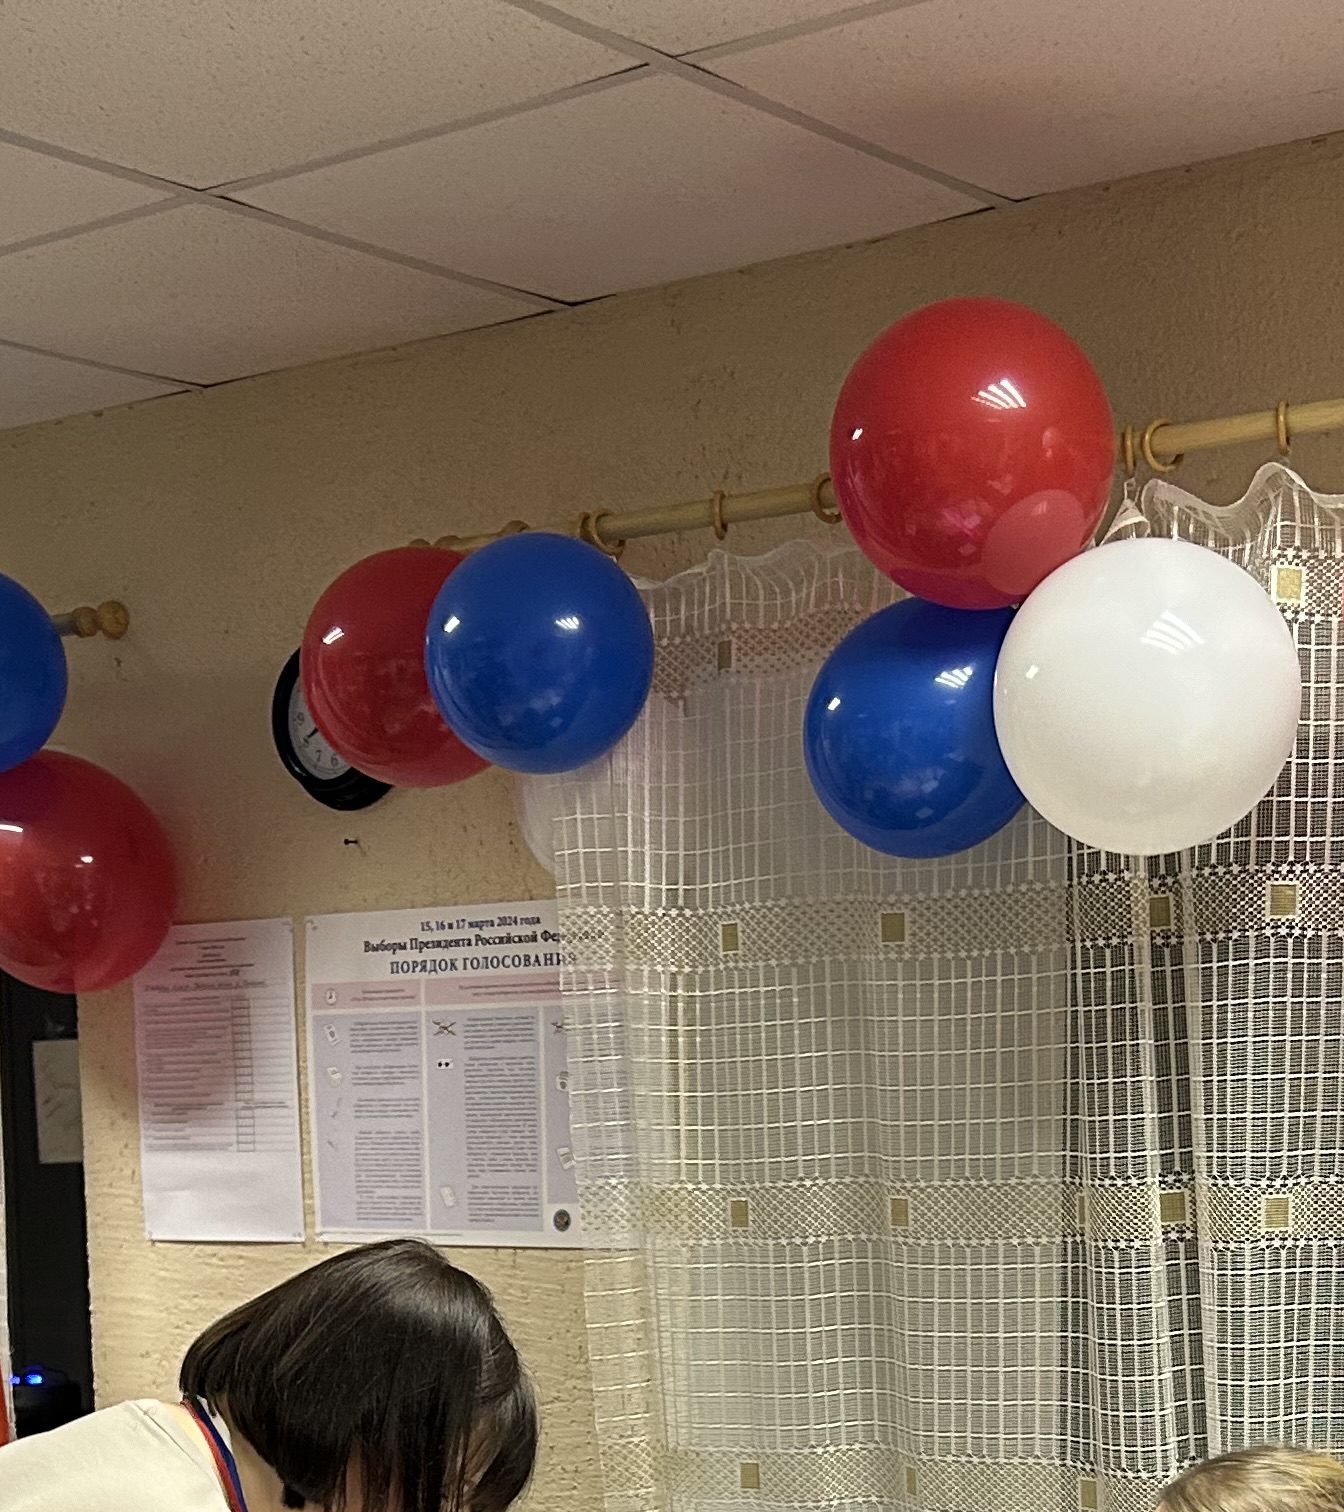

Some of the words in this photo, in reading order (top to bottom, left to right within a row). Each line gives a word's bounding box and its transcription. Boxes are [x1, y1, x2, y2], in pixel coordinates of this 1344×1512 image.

[435, 921, 446, 931] 16
[456, 919, 466, 929] 17
[497, 916, 518, 927] 2024
[363, 938, 407, 955] Выборы
[409, 936, 472, 953] Президента
[474, 931, 538, 947] Российской
[390, 957, 458, 974] ПОРЯДОК
